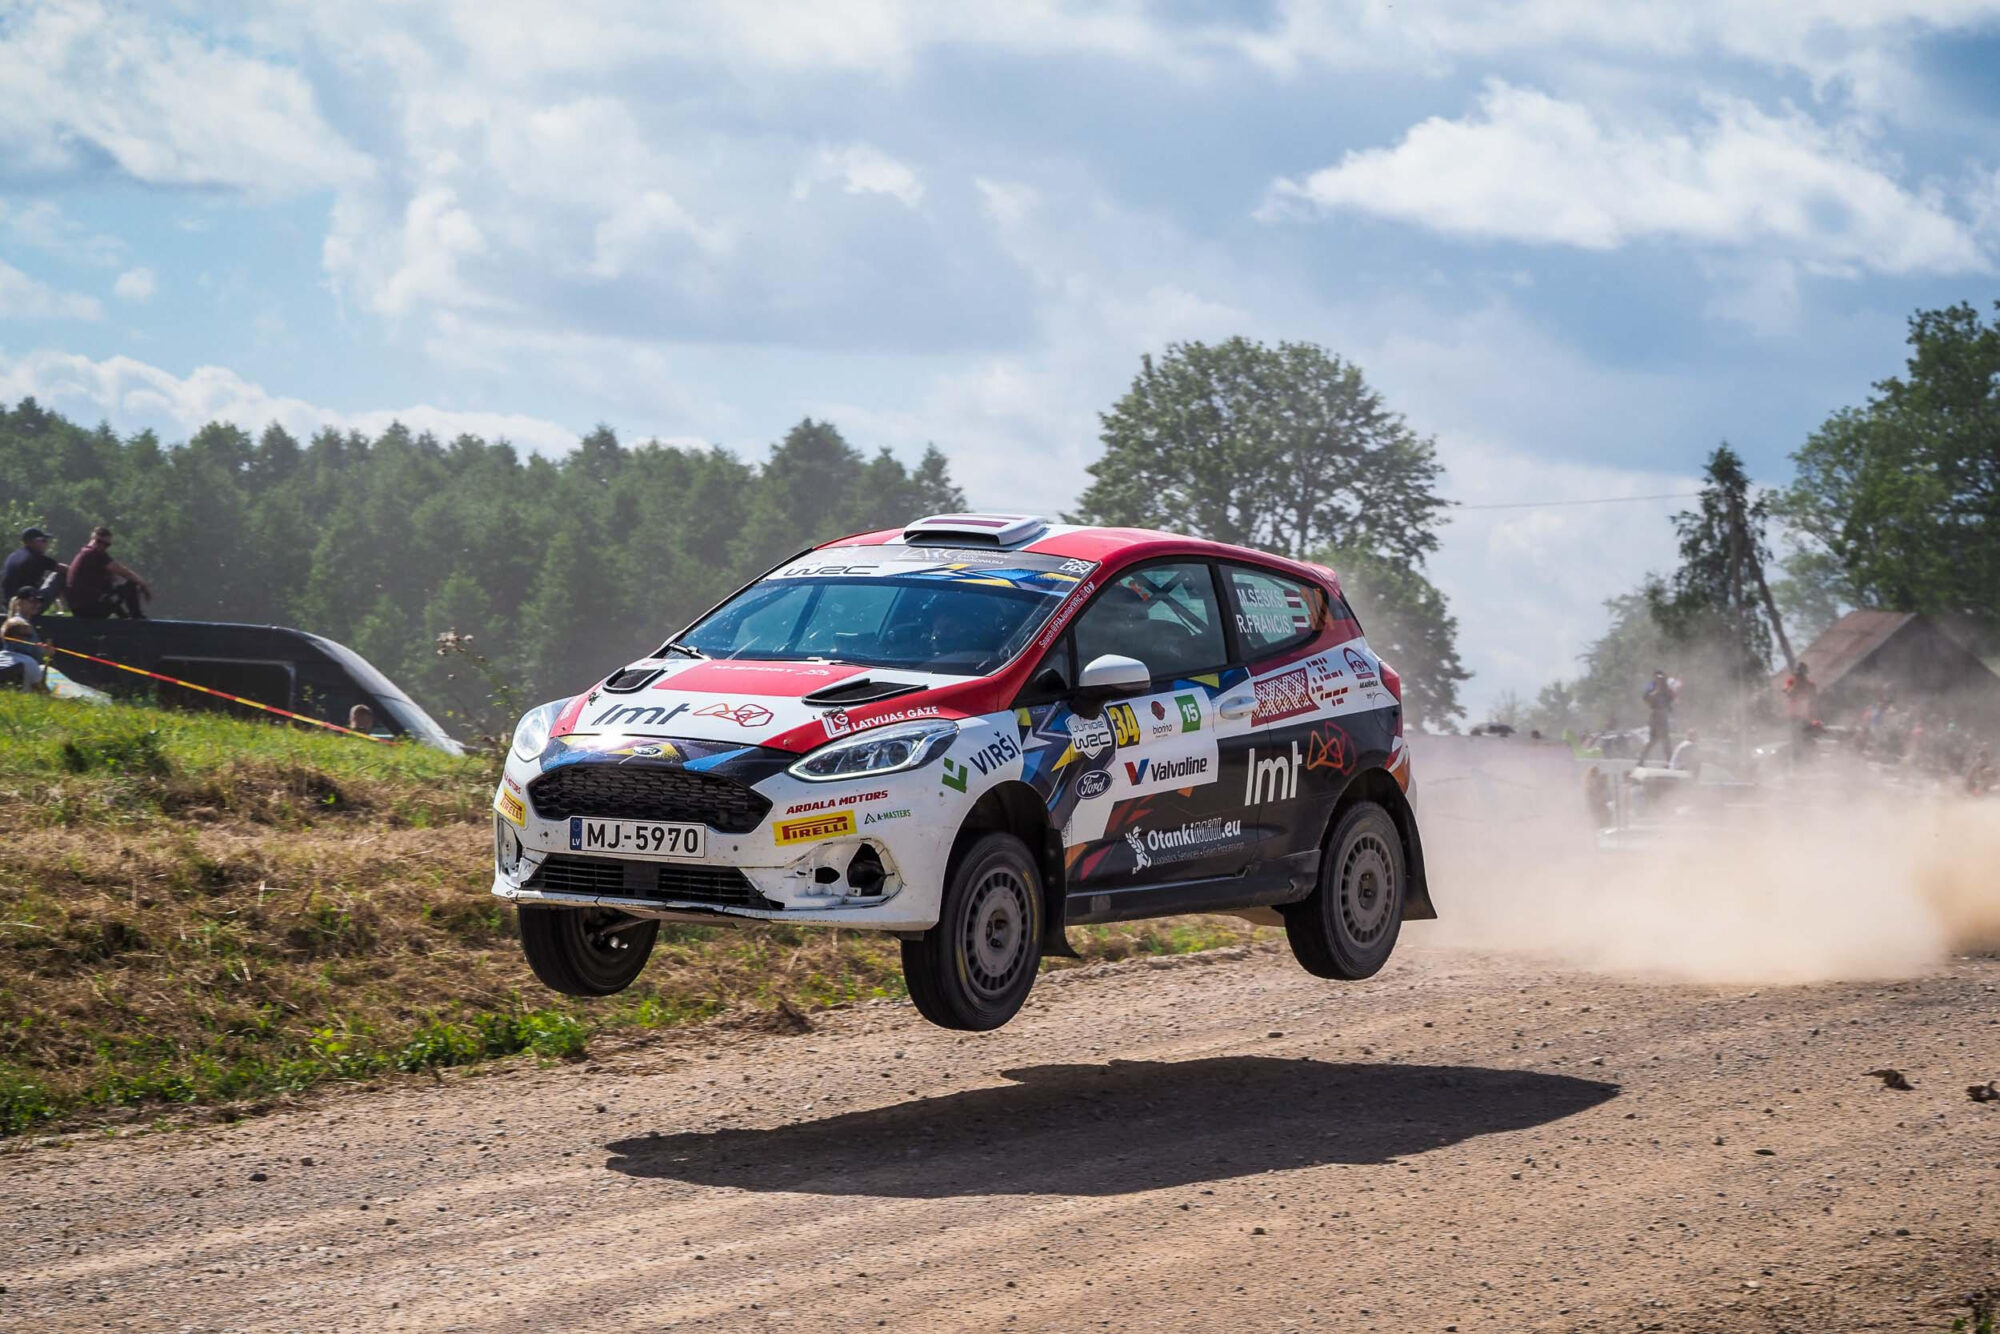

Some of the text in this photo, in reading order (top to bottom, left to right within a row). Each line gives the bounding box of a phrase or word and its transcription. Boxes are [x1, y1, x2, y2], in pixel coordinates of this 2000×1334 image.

[783, 565, 879, 576] WRC
[1236, 589, 1283, 608] M.SESKS
[1236, 614, 1291, 634] R.FRANCIS
[591, 703, 690, 725] lmt
[853, 711, 905, 731] LATVIJAS
[907, 706, 939, 718] GĀZE
[1182, 702, 1199, 723] 15
[1110, 703, 1140, 746] 34
[1073, 731, 1112, 750] WRC
[969, 731, 1021, 775] VIRŠI
[1151, 756, 1208, 782] Valvoline
[1244, 741, 1302, 806] lmt
[1081, 773, 1106, 796] Ford
[838, 790, 889, 806] MOTORS
[571, 823, 698, 854] LV MJ-5970
[781, 815, 848, 841] PIRELLI
